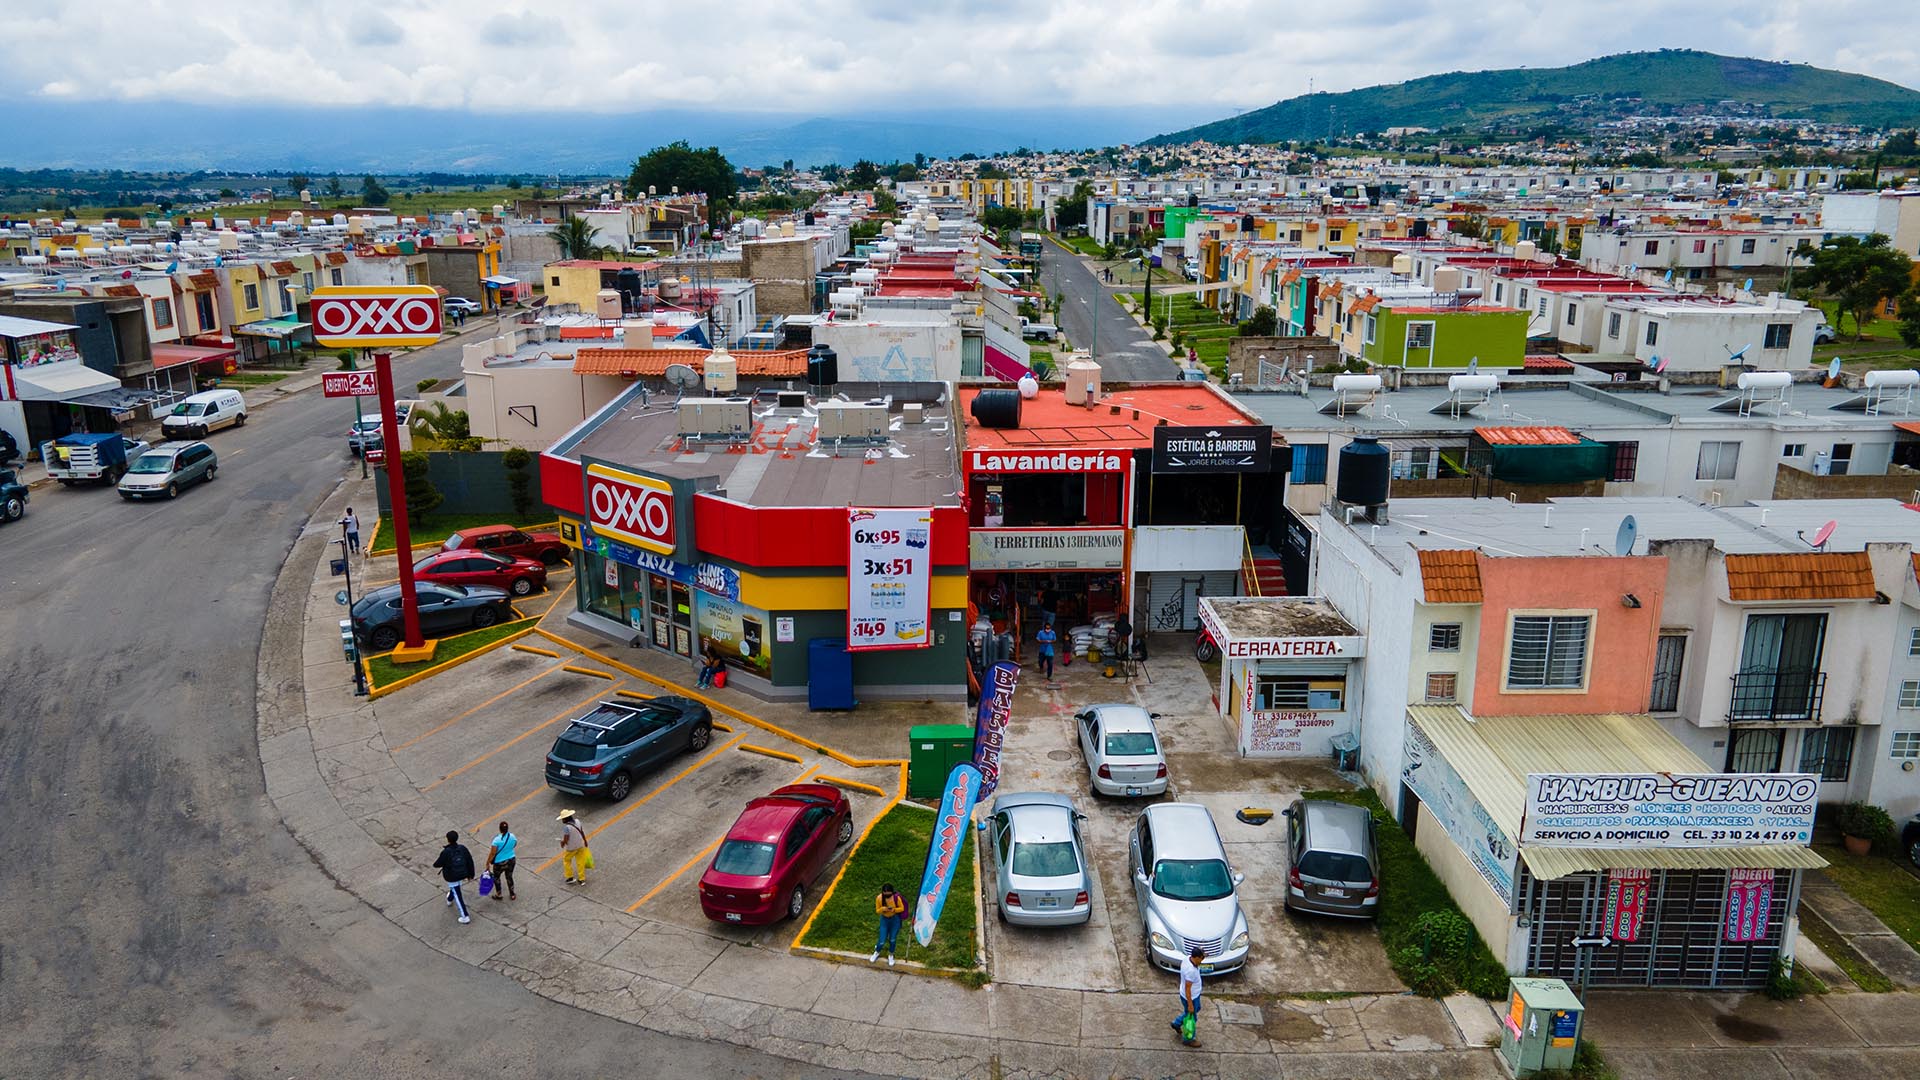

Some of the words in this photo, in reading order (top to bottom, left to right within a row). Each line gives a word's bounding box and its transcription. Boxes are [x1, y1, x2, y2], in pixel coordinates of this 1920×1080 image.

[317, 300, 435, 336] OXXO
[325, 378, 349, 393] ABIERTO
[349, 373, 374, 389] 24
[1167, 438, 1206, 452] ESTÉTICA
[1207, 440, 1214, 452] &
[1215, 440, 1257, 452] BARBERIA
[973, 450, 1121, 471] Lavandería
[591, 482, 669, 537] OXXO
[994, 534, 1065, 549] FERRETERÍAS
[697, 562, 726, 579] CLINK
[852, 622, 886, 637] $149
[1228, 640, 1337, 657] CERRAJERIA
[1246, 670, 1254, 712] LLAVES
[1253, 712, 1268, 720] TEL
[1537, 777, 1817, 803] HAMBUR-GUEANDO
[1544, 803, 1630, 815] HAMBURGUESAS
[1641, 803, 1692, 814] LONCHES
[1701, 804, 1727, 814] HOT
[1727, 804, 1762, 815] DOGS
[1772, 804, 1812, 815] ALITAS
[1542, 817, 1623, 827] SALCHIPULPOS
[1631, 816, 1669, 826] PAPAS
[1669, 816, 1680, 826] A
[1680, 816, 1695, 827] LA
[1696, 816, 1754, 827] FRANCESA
[1767, 818, 1776, 827] Y
[1534, 831, 1591, 840] SERVICIO
[1593, 831, 1603, 840] A
[1605, 830, 1670, 840] DOMICILIO
[1682, 830, 1708, 840] CEL.
[1711, 831, 1727, 840] 33
[1729, 831, 1742, 840] 10
[1744, 831, 1760, 840] 24
[1763, 831, 1779, 840] 47
[1781, 831, 1797, 841] 69
[1731, 868, 1775, 880] ABIERTO
[1624, 887, 1634, 907] HOT
[1729, 891, 1740, 939] LONCHES
[1743, 890, 1756, 938] PAPAS
[1620, 912, 1631, 938] DOGS
